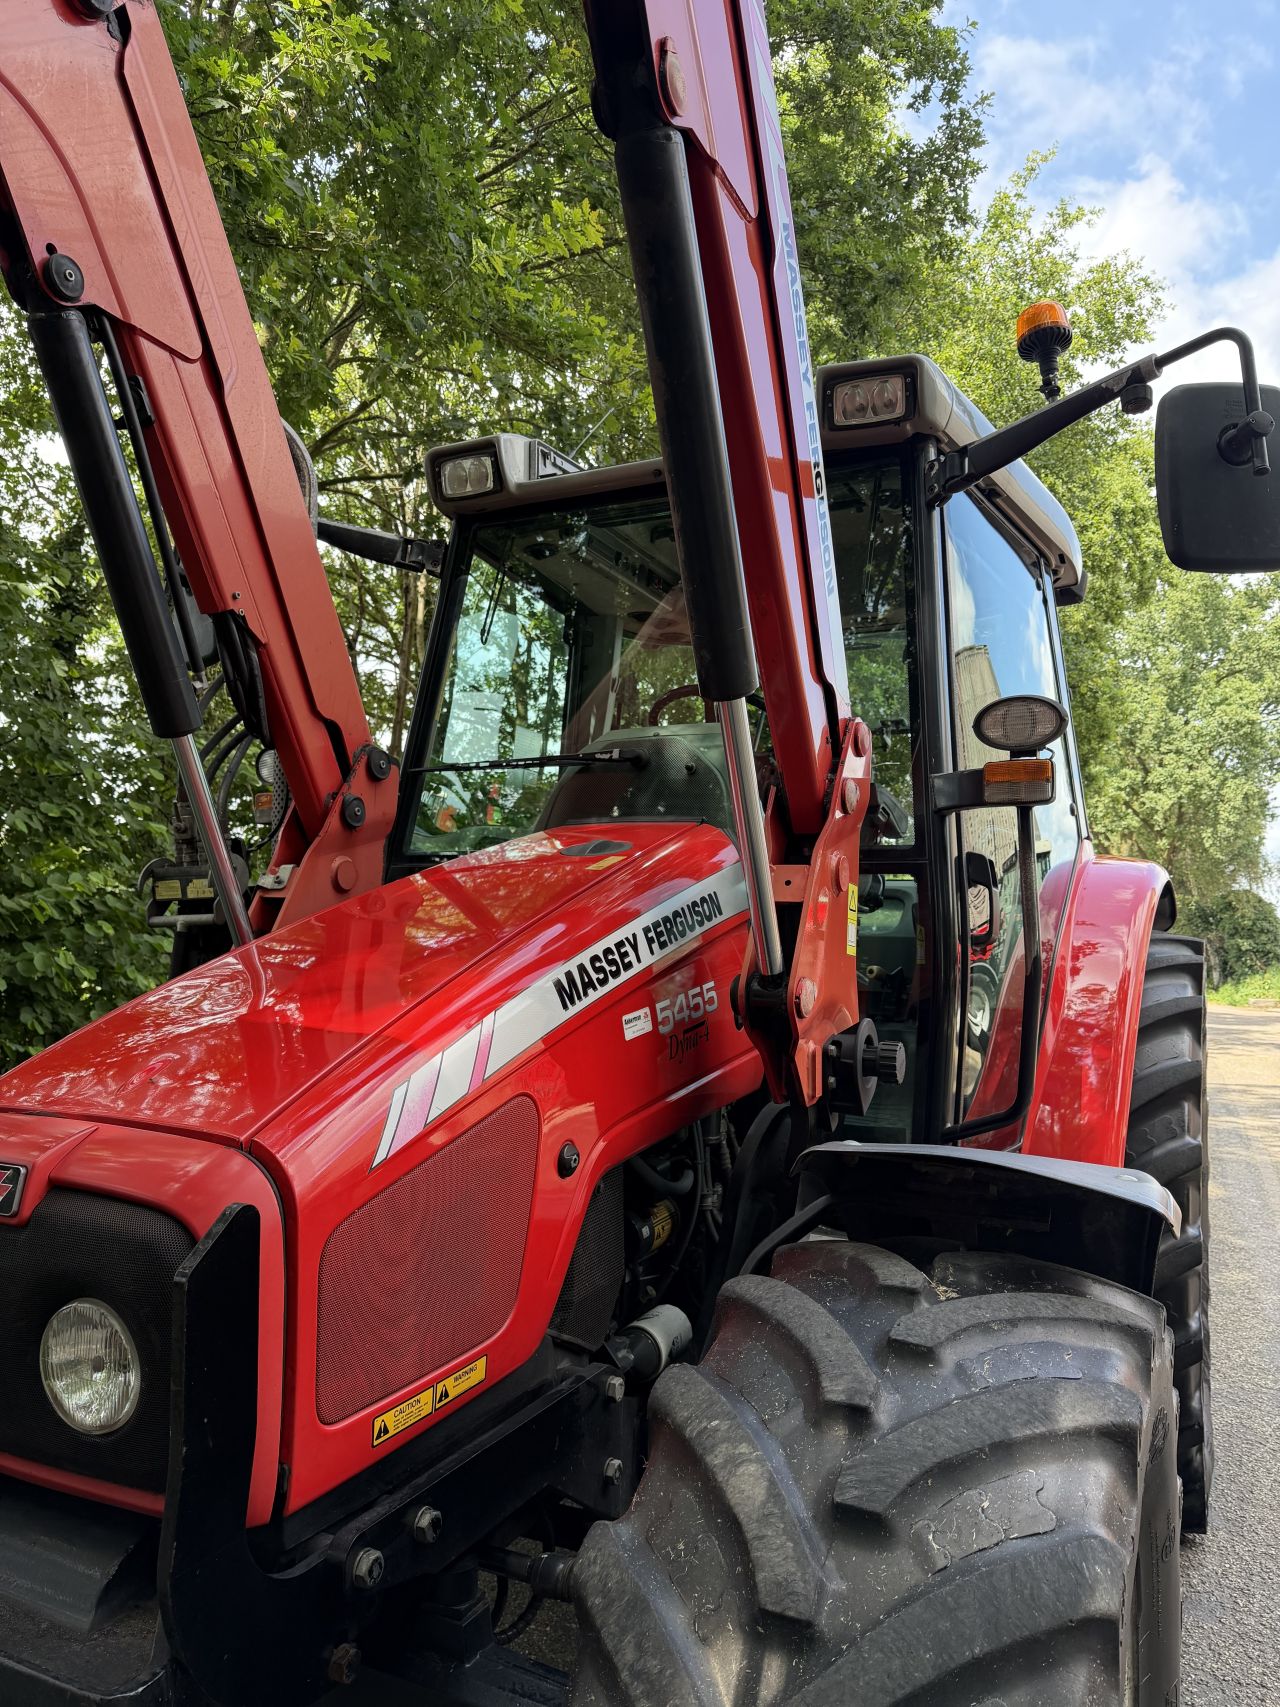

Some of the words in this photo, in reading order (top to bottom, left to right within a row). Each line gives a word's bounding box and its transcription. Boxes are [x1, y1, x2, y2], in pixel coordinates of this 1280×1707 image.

[782, 222, 812, 387] MASSEY
[806, 401, 834, 598] FERGUSON
[552, 932, 642, 1011] MASSEY
[642, 890, 723, 956] FERGUSON
[655, 981, 718, 1035] 5455
[668, 1020, 710, 1062] Dyna-4
[453, 1364, 478, 1383] WARNING
[394, 1397, 421, 1417] CAUTION
